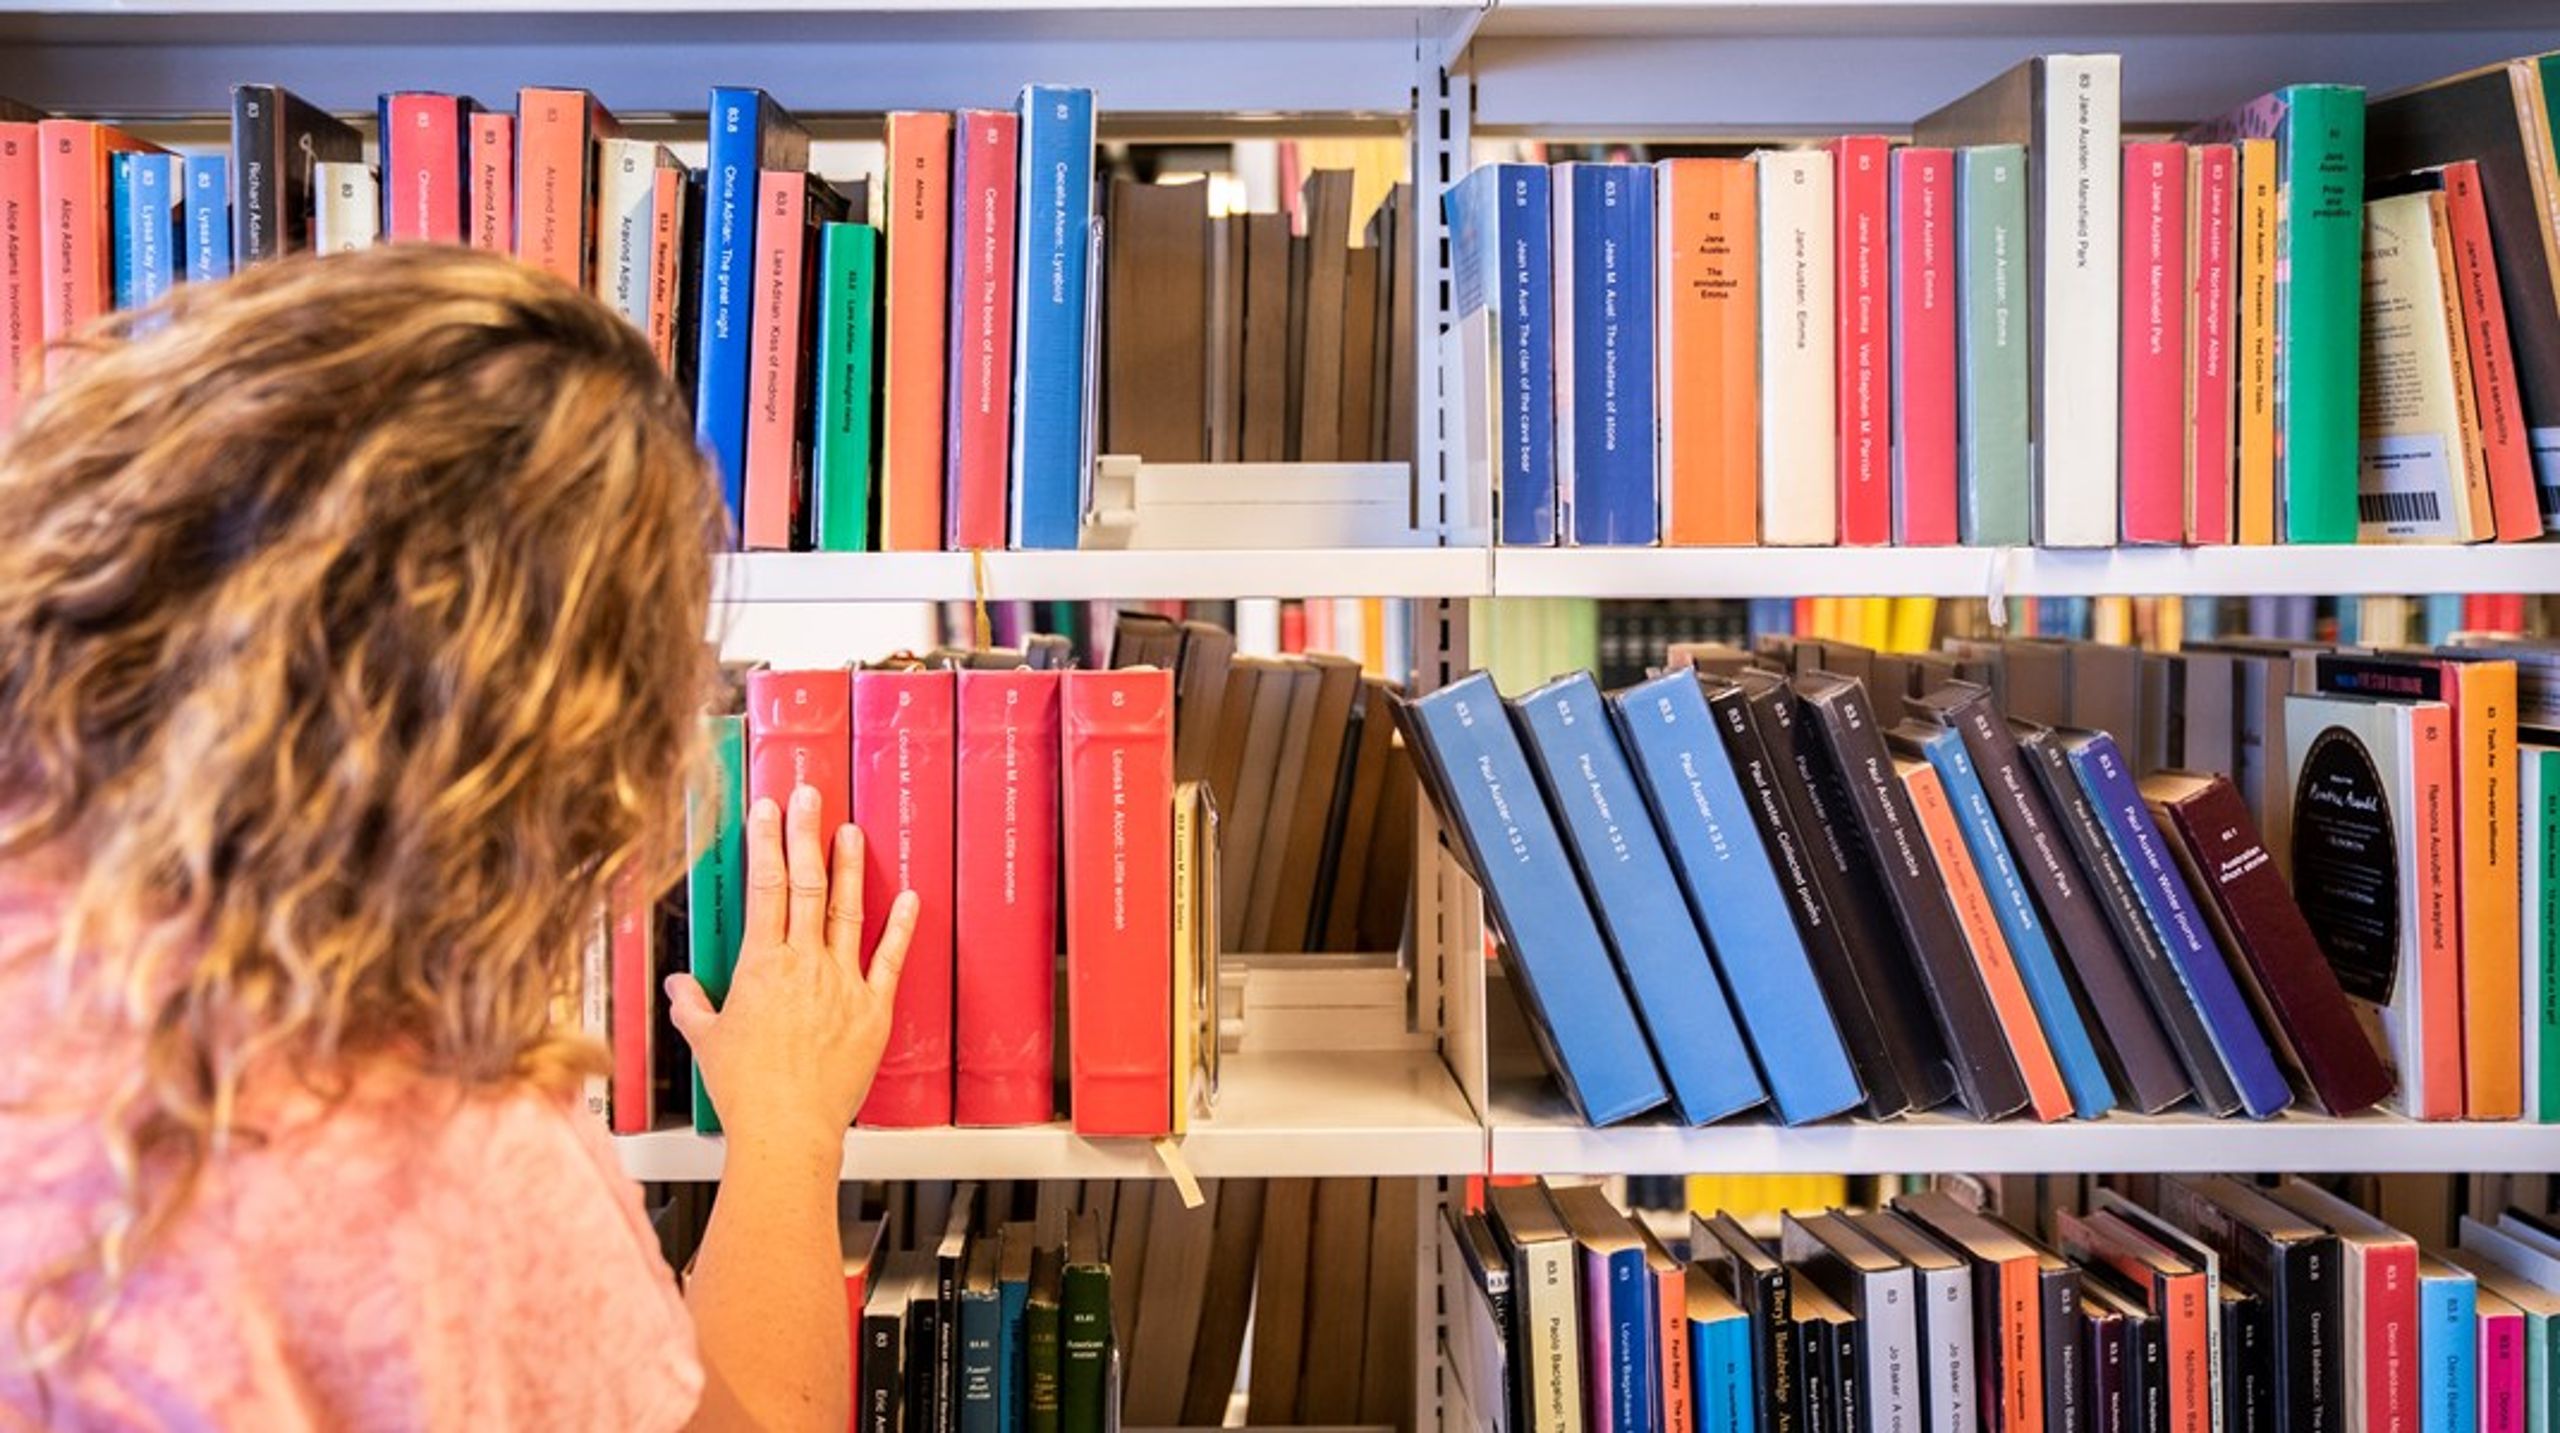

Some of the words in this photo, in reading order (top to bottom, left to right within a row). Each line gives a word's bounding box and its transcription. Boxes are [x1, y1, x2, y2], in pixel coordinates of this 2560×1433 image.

[2078, 73, 2089, 88] 83
[247, 102, 258, 118] 83
[726, 107, 738, 132] 83.8
[1056, 104, 1067, 119] 83
[2077, 94, 2089, 124] Jane
[248, 162, 260, 209] Richard
[723, 165, 736, 200] Chris
[1055, 162, 1067, 206] Cecelia
[1515, 180, 1527, 206] 83.8
[1603, 180, 1615, 206] 83.8
[2150, 182, 2162, 212] Jane
[60, 198, 71, 229] Alice
[1922, 187, 1933, 217] Jane
[2077, 178, 2089, 237] Mansfield
[2210, 184, 2222, 214] Jane
[6, 200, 18, 229] Alice
[1858, 212, 1869, 243] Jane
[619, 216, 632, 261] Aravind
[1515, 239, 1527, 268] Jean
[1604, 239, 1615, 268] Jean
[1795, 228, 1805, 258] Jane
[1994, 226, 2007, 256] Jane
[719, 249, 732, 272] The
[772, 250, 784, 276] Lara
[2077, 240, 2089, 268] Park
[2465, 240, 2477, 269] Jane
[716, 274, 731, 304] great
[983, 280, 995, 303] The
[1052, 253, 1065, 304] Lyrebird
[1922, 270, 1934, 308] Emma
[2150, 265, 2161, 324] Mansfield
[2206, 268, 2220, 336] Northanger
[715, 308, 729, 338] night
[982, 305, 994, 336] book
[1519, 324, 1529, 347] The
[1605, 324, 1616, 347] The
[1796, 310, 1806, 348] Emma
[1995, 308, 2008, 346] Emma
[768, 325, 780, 351] Kiss
[982, 339, 993, 352] of
[2150, 327, 2161, 354] Park
[2479, 320, 2493, 357] Sense
[768, 354, 780, 367] of
[1519, 349, 1529, 374] clan
[2205, 339, 2218, 376] Abbey
[2485, 361, 2497, 382] and
[980, 354, 993, 413] tomorrow
[1520, 377, 1530, 389] of
[1605, 349, 1616, 398] shelters
[764, 370, 779, 422] midnight
[1520, 392, 1530, 412] the
[1605, 401, 1616, 413] of
[1520, 414, 1530, 442] cave
[2489, 385, 2508, 446] sensibility
[1605, 416, 1615, 450] stone
[1520, 446, 1530, 473] bear
[1004, 726, 1016, 767] Louisa
[1111, 749, 1124, 790] Louisa
[1476, 754, 1496, 783] Paul
[1578, 753, 1596, 780] Paul
[1678, 752, 1697, 779] Paul
[1843, 703, 1860, 729] 83.8
[1865, 758, 1884, 784] Paul
[1892, 828, 1919, 877] Invisible
[1795, 755, 1812, 780] Paul
[1822, 825, 1848, 873] Invisible
[2427, 784, 2440, 834] Ramona
[898, 829, 909, 860] Little
[1004, 827, 1016, 859] Little
[1748, 761, 1767, 788] Paul
[1775, 831, 1806, 886] Collected
[1796, 887, 1822, 927] poems
[2000, 766, 2018, 791] Paul
[2032, 833, 2058, 872] Sunset
[2052, 873, 2072, 899] Park
[2487, 820, 2497, 866] billionaire
[1112, 854, 1125, 883] Little
[2220, 866, 2244, 883] short
[2244, 853, 2269, 871] stories
[2221, 846, 2261, 871] Australian
[1004, 861, 1015, 903] women
[2123, 806, 2142, 832] Paul
[2156, 874, 2180, 911] Winter
[2172, 911, 2202, 952] journal
[1112, 887, 1124, 929] women
[2429, 892, 2444, 950] Awayland
[1549, 1317, 1560, 1350] Paolo
[1620, 1322, 1630, 1361] Louise
[2311, 1312, 2321, 1346] David
[2386, 1322, 2397, 1356] David
[1888, 1345, 1899, 1359] Jo
[1948, 1343, 1958, 1358] Jo
[1773, 1331, 1788, 1402] Bainbridge
[2063, 1345, 2073, 1405] Nicholson
[2185, 1350, 2195, 1409] Nicholson
[874, 1388, 886, 1413] Eric
[2312, 1406, 2322, 1427] The
